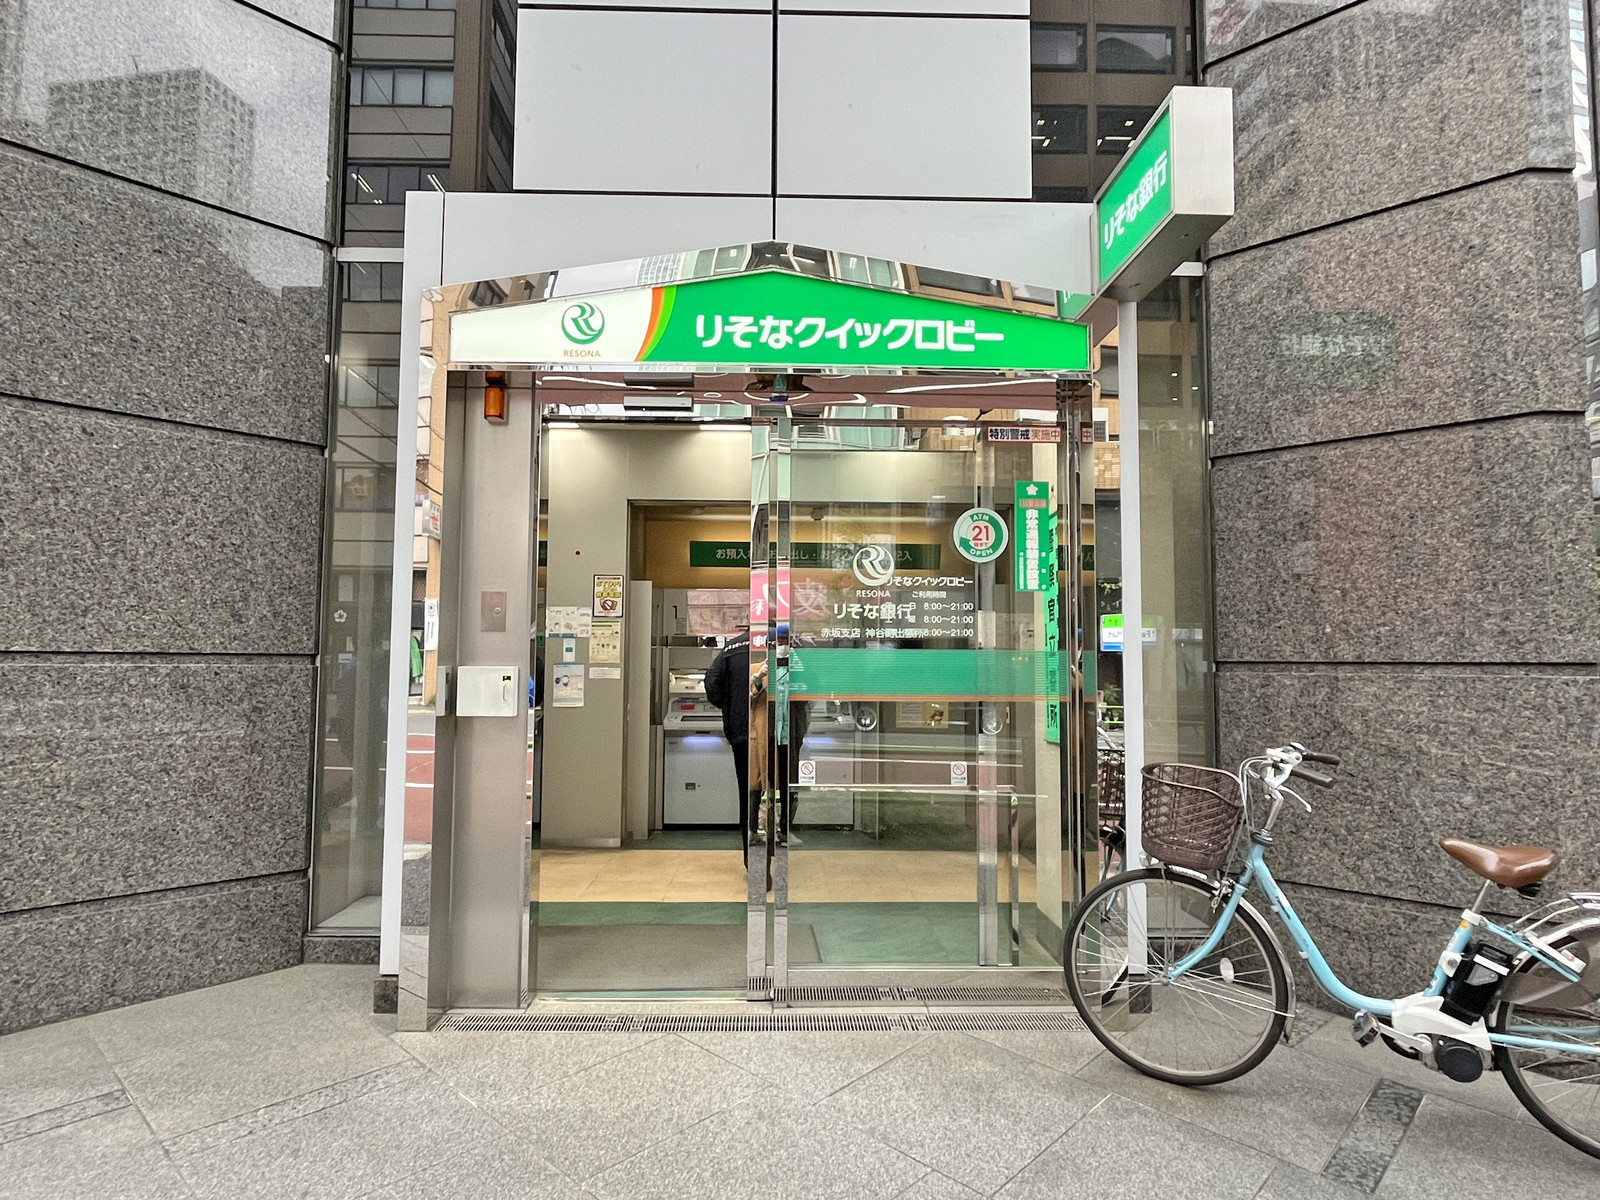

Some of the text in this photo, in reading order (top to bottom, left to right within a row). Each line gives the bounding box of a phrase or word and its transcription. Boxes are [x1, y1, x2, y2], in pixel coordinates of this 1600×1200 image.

[1104, 150, 1167, 250] りそな銀行
[696, 314, 1005, 352] りそなクイックロビー
[563, 349, 601, 358] RESONA
[989, 428, 1060, 440] 特別警戒実施中
[973, 513, 990, 521] ATM
[972, 525, 990, 541] 21
[970, 548, 993, 557] OPEN
[856, 589, 892, 598] RESONA
[912, 590, 947, 598] ご利用時間
[833, 602, 911, 620] りそな銀行
[821, 627, 861, 638] 赤坂支店
